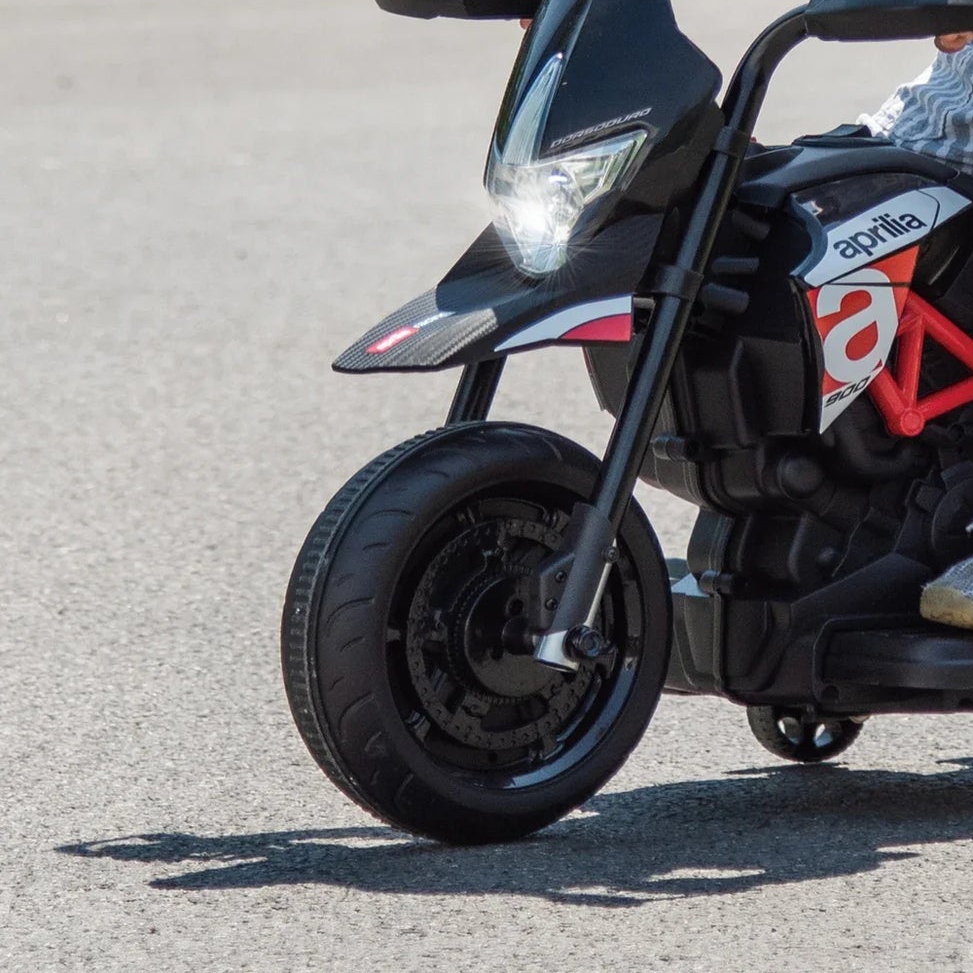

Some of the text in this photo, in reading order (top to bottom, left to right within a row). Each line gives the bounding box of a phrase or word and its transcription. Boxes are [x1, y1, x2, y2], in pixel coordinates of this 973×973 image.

[550, 107, 652, 148] DORSODURO
[833, 213, 927, 259] aprilia
[824, 375, 871, 408] 900
